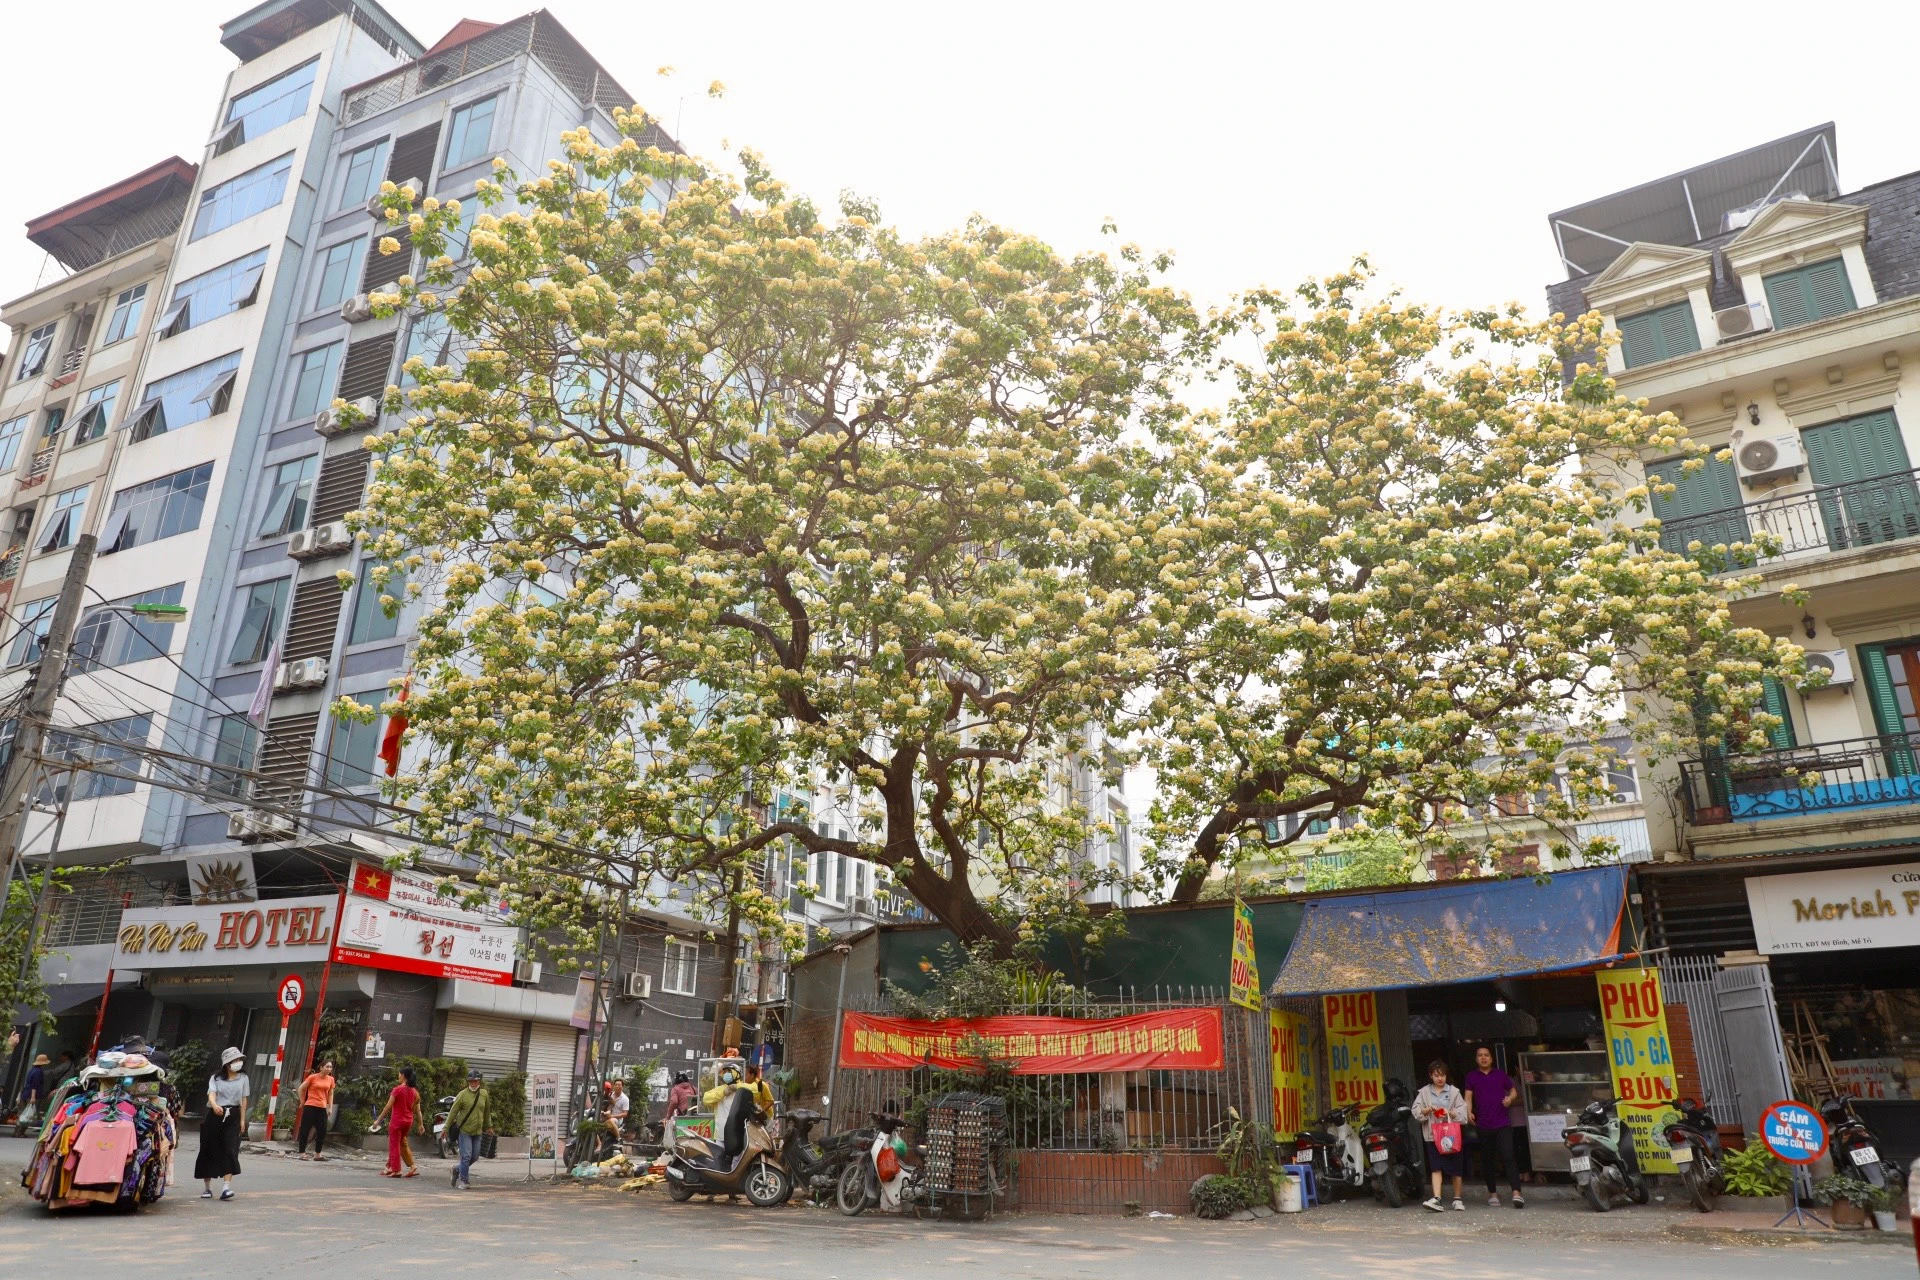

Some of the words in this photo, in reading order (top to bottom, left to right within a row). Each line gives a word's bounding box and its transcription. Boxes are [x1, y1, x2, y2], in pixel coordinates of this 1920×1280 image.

[1792, 889, 1897, 922] Moriah
[178, 921, 208, 952] Sun
[213, 906, 330, 949] HOTEL
[479, 934, 503, 948] 부동산
[469, 948, 492, 960] 이삿짐
[494, 952, 508, 963] 센터
[1832, 938, 1850, 947] Đình,
[1601, 969, 1659, 1019] PHỞ
[1325, 991, 1374, 1028] PHỞ
[868, 1027, 886, 1057] ĐỘNG
[887, 1030, 912, 1056] PHÒNG
[913, 1032, 935, 1057] CHÁY
[936, 1029, 954, 1060] TỐT,
[1009, 1031, 1037, 1057] CHỮA
[1040, 1031, 1067, 1057] CHÁY
[1070, 1032, 1089, 1061] KỊP
[1092, 1028, 1116, 1055] THỜI
[1117, 1026, 1132, 1054] VÀ
[1134, 1025, 1149, 1053] CÓ
[1151, 1024, 1175, 1057] HIỆU
[1177, 1021, 1202, 1054] QUẢ.
[1612, 1031, 1635, 1067] BÒ
[1647, 1030, 1671, 1065] GÀ
[1332, 1039, 1350, 1071] BÒ
[1361, 1039, 1379, 1071] GÀ
[535, 1086, 545, 1100] BÚN
[1335, 1076, 1379, 1102] BÚN
[1618, 1072, 1673, 1101] BÚN
[1780, 1110, 1809, 1125] CẤM
[1635, 1139, 1649, 1149] HỊT
[1768, 1135, 1789, 1147] TRƯỚC
[1790, 1137, 1804, 1149] CỬA
[1804, 1141, 1819, 1151] NHÀ
[1796, 1128, 1813, 1140] XE
